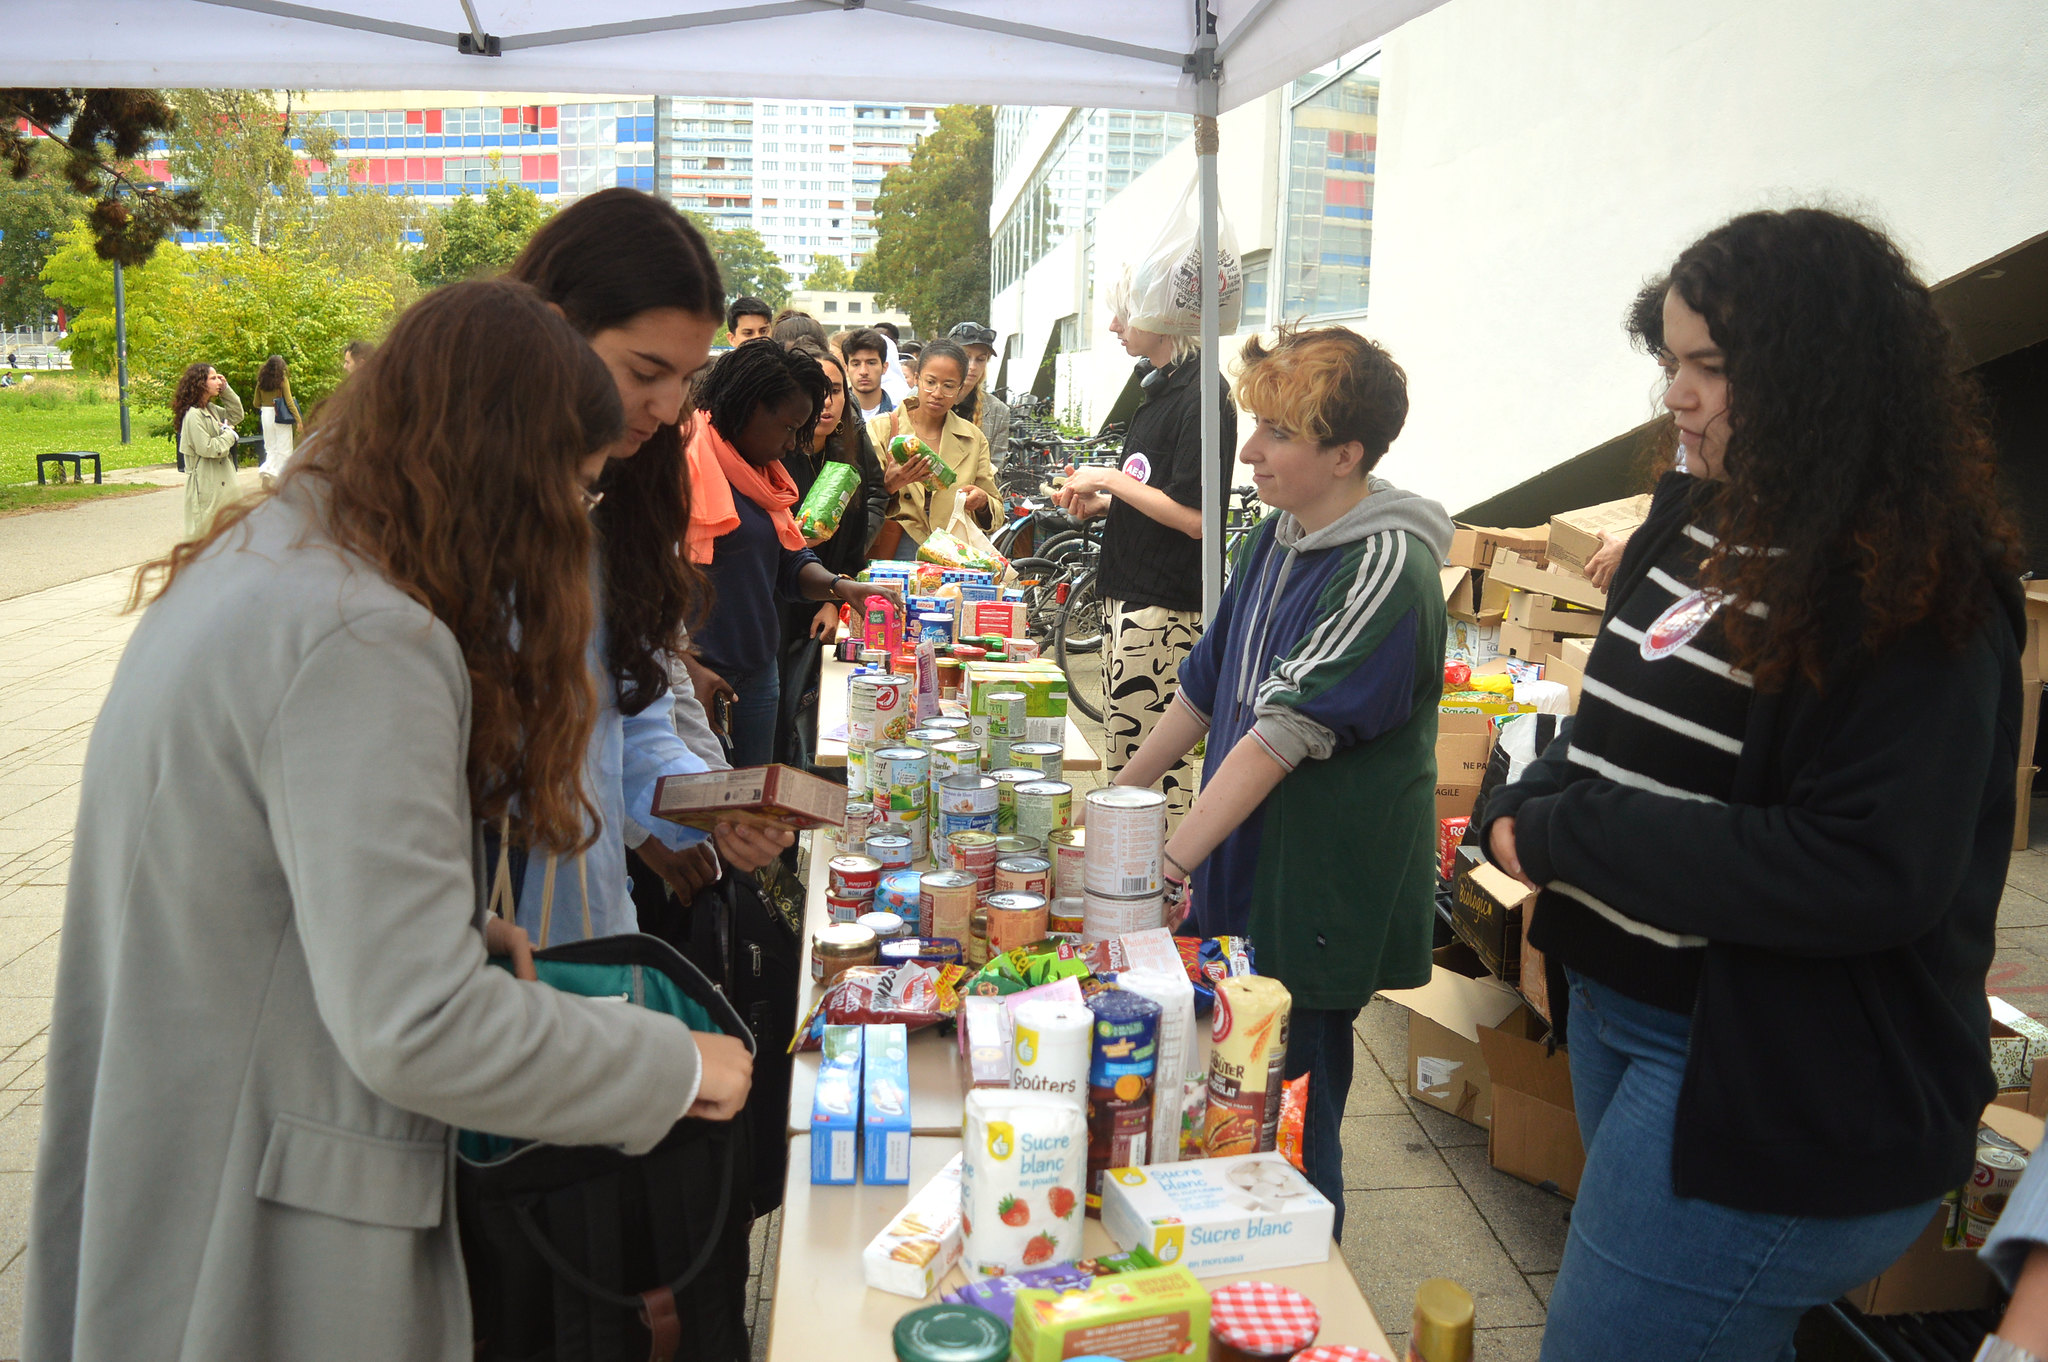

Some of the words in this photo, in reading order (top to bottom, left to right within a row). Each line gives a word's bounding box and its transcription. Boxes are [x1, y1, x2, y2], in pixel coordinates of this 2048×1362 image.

[1126, 464, 1145, 480] AES
[1463, 761, 1475, 770] NE
[1476, 761, 1487, 770] PA
[1435, 788, 1460, 797] AGILE
[1450, 826, 1466, 837] RO
[1014, 1067, 1076, 1094] Goûters
[1021, 1132, 1070, 1151] Sucre
[1020, 1154, 1065, 1175] blanc
[1150, 1168, 1203, 1181] Sucre
[1159, 1178, 1208, 1191] blanc
[1190, 1225, 1241, 1245] Sucre
[1247, 1217, 1294, 1238] blanc
[1188, 1260, 1200, 1268] en
[1201, 1253, 1245, 1266] morceaux
